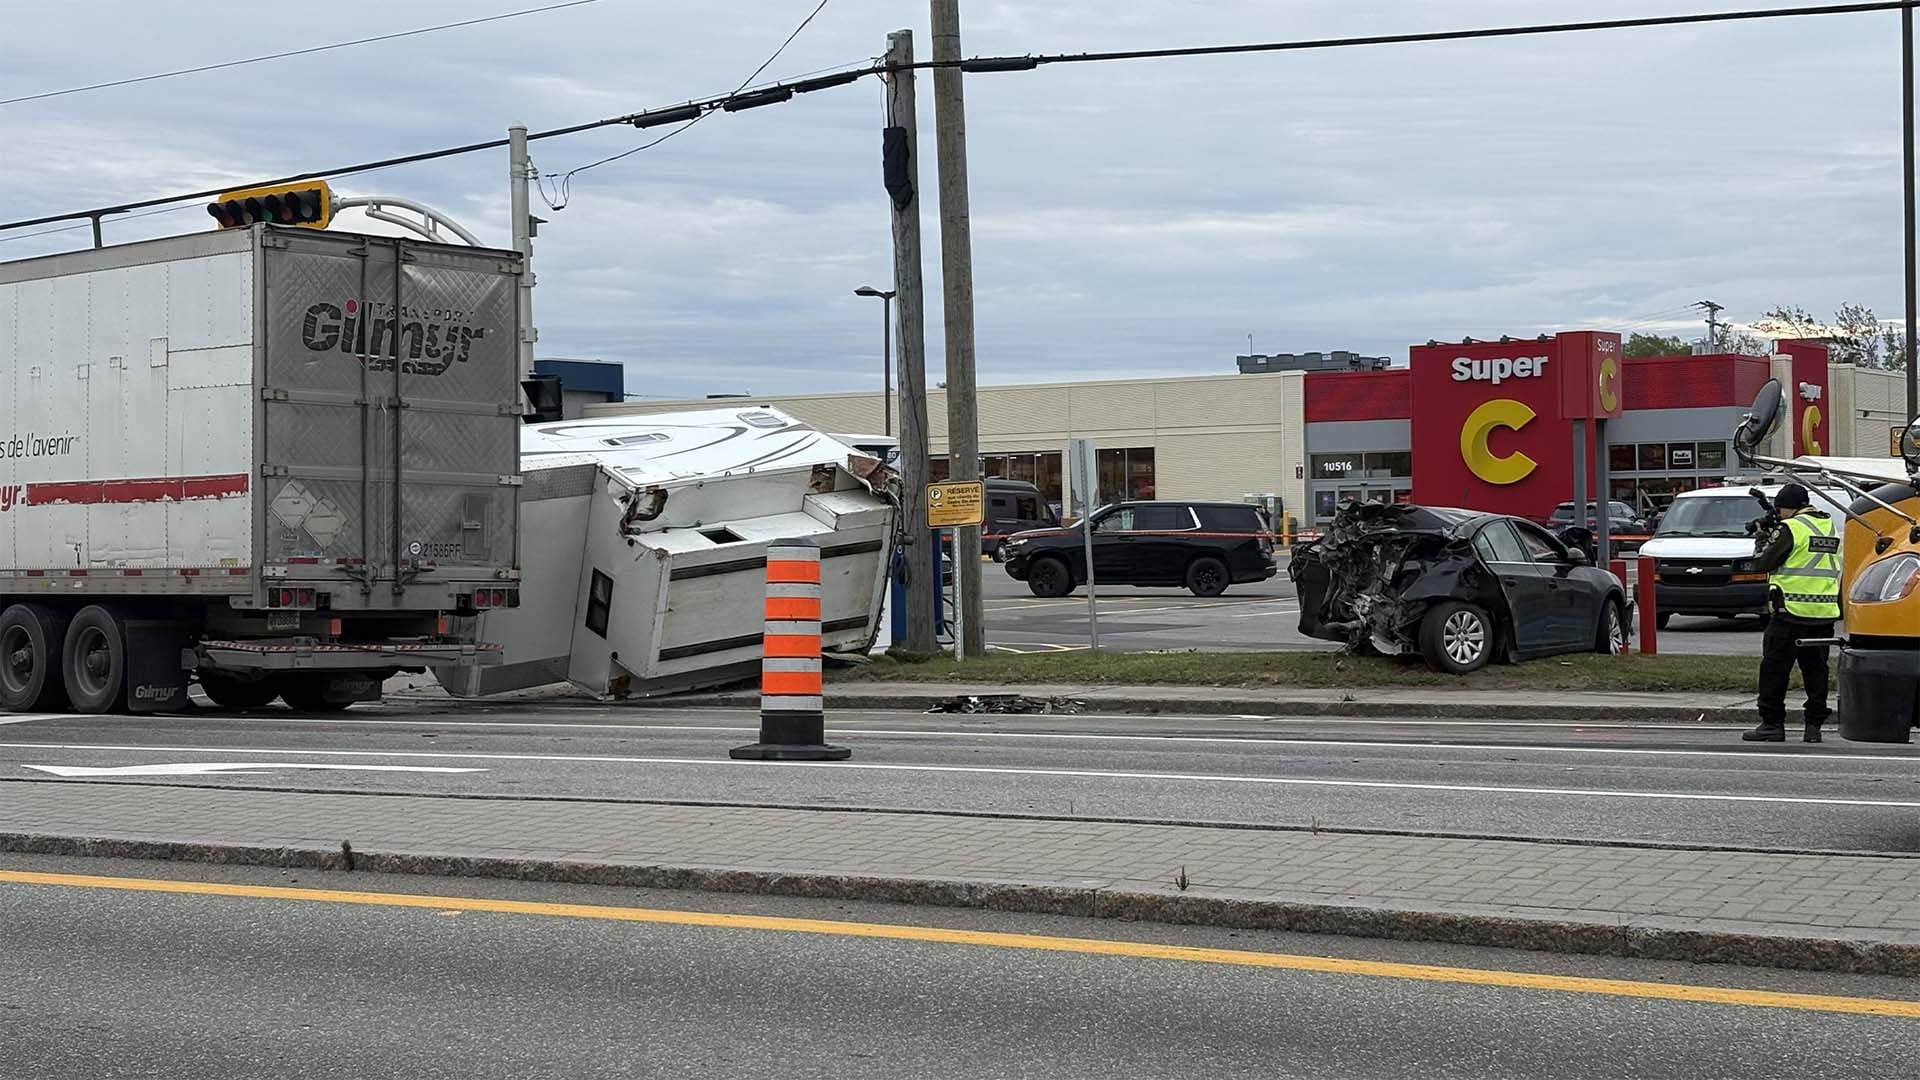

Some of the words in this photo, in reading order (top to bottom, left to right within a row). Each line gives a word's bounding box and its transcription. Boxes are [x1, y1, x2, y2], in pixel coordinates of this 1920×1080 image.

[303, 299, 485, 375] Gilmyr
[1597, 338, 1616, 354] Super
[1451, 356, 1549, 385] Super
[1600, 357, 1618, 413] C
[8, 433, 24, 458] de
[26, 430, 75, 457] l'avenir
[1460, 398, 1538, 485] C
[1323, 461, 1352, 471] 10516
